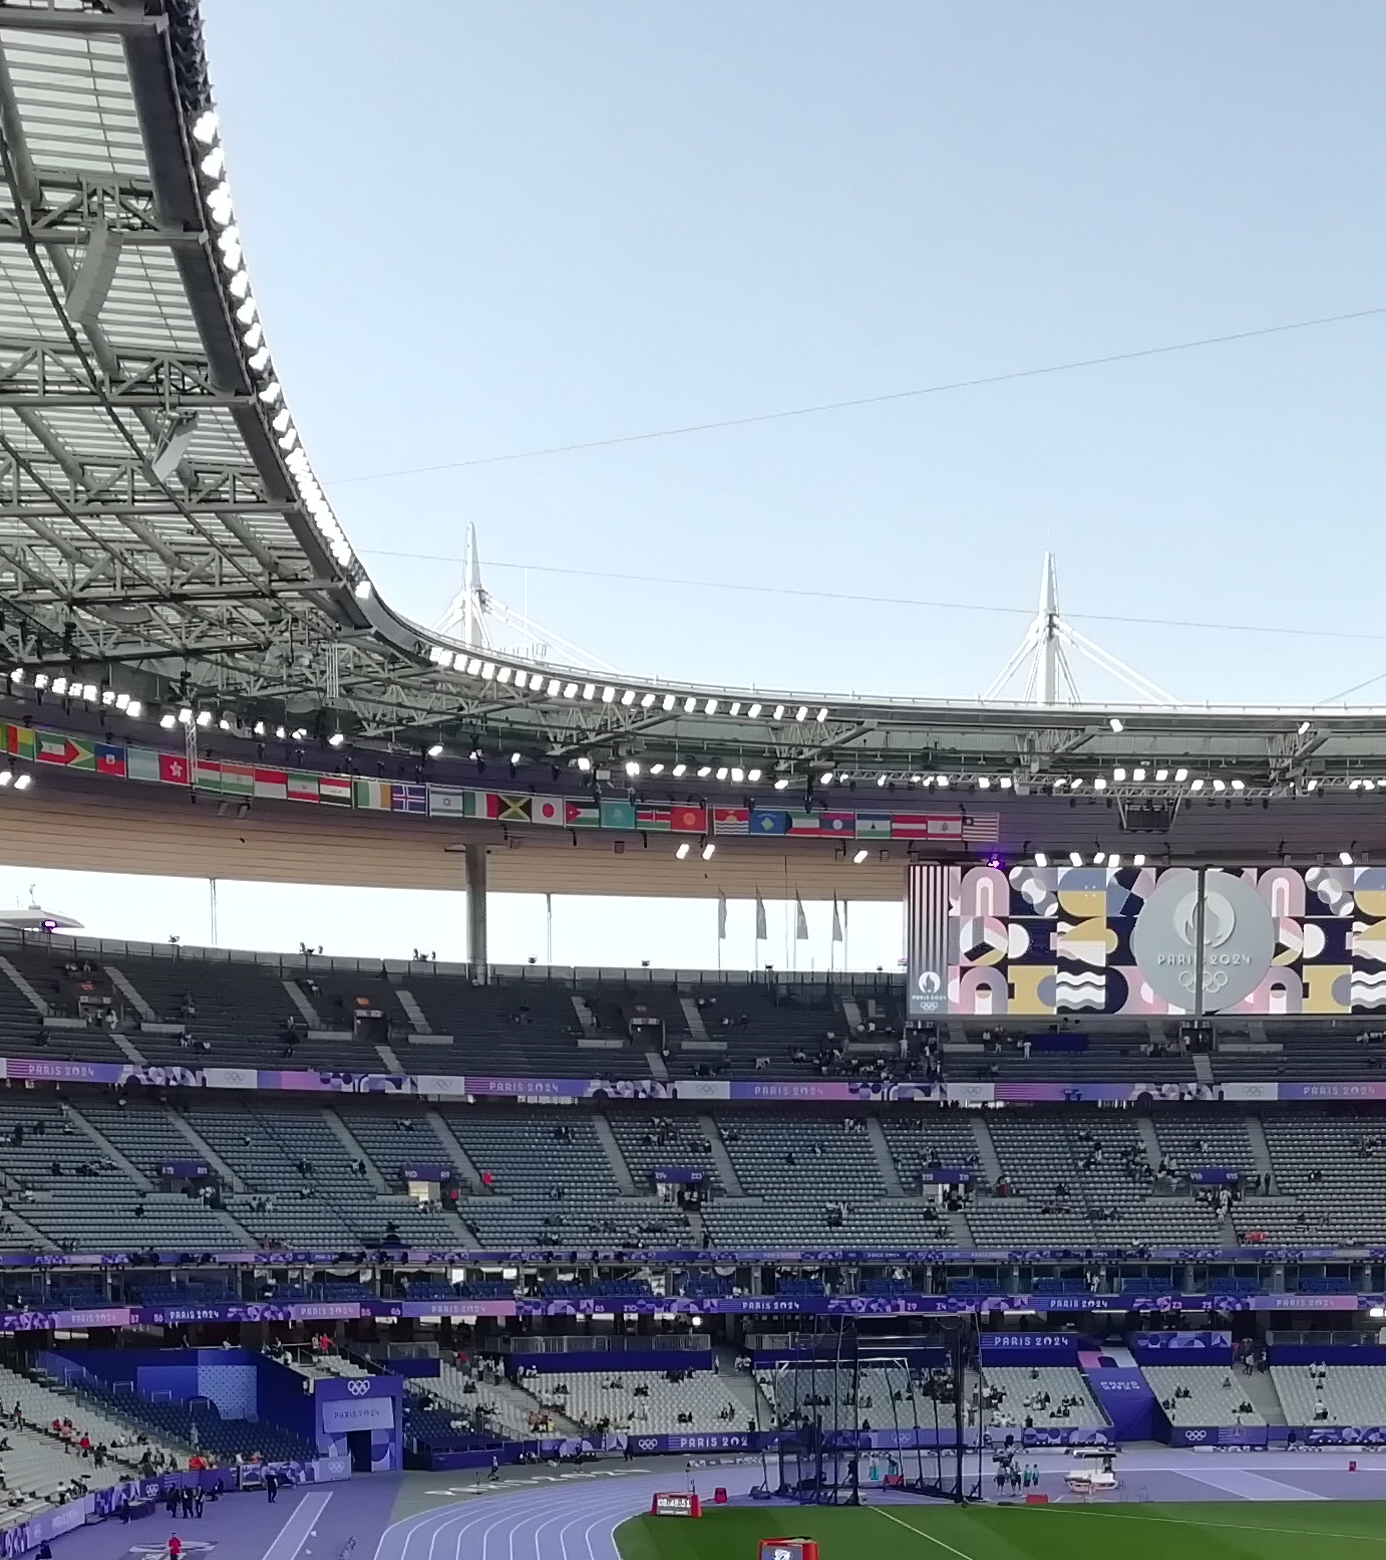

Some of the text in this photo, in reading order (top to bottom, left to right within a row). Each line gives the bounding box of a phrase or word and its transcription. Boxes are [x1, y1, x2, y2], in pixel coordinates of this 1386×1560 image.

[1158, 954, 1252, 965] PARI 2024
[29, 1065, 94, 1077] PARIS 2024
[489, 1082, 559, 1092] PARIS 2024
[754, 1086, 824, 1095] PARIS 2024
[1303, 1086, 1375, 1095] PARIS 2024
[431, 1304, 486, 1313] PARIS 2024
[743, 1302, 770, 1310] PARIS
[1050, 1300, 1108, 1308] PARIS 2024
[170, 1310, 219, 1319] PARIS 2024
[301, 1306, 353, 1316] PARIS 2024
[71, 1313, 116, 1323] PARIS 2024
[994, 1336, 1068, 1346] PARIS 2024
[680, 1437, 748, 1448] PARIS 202
